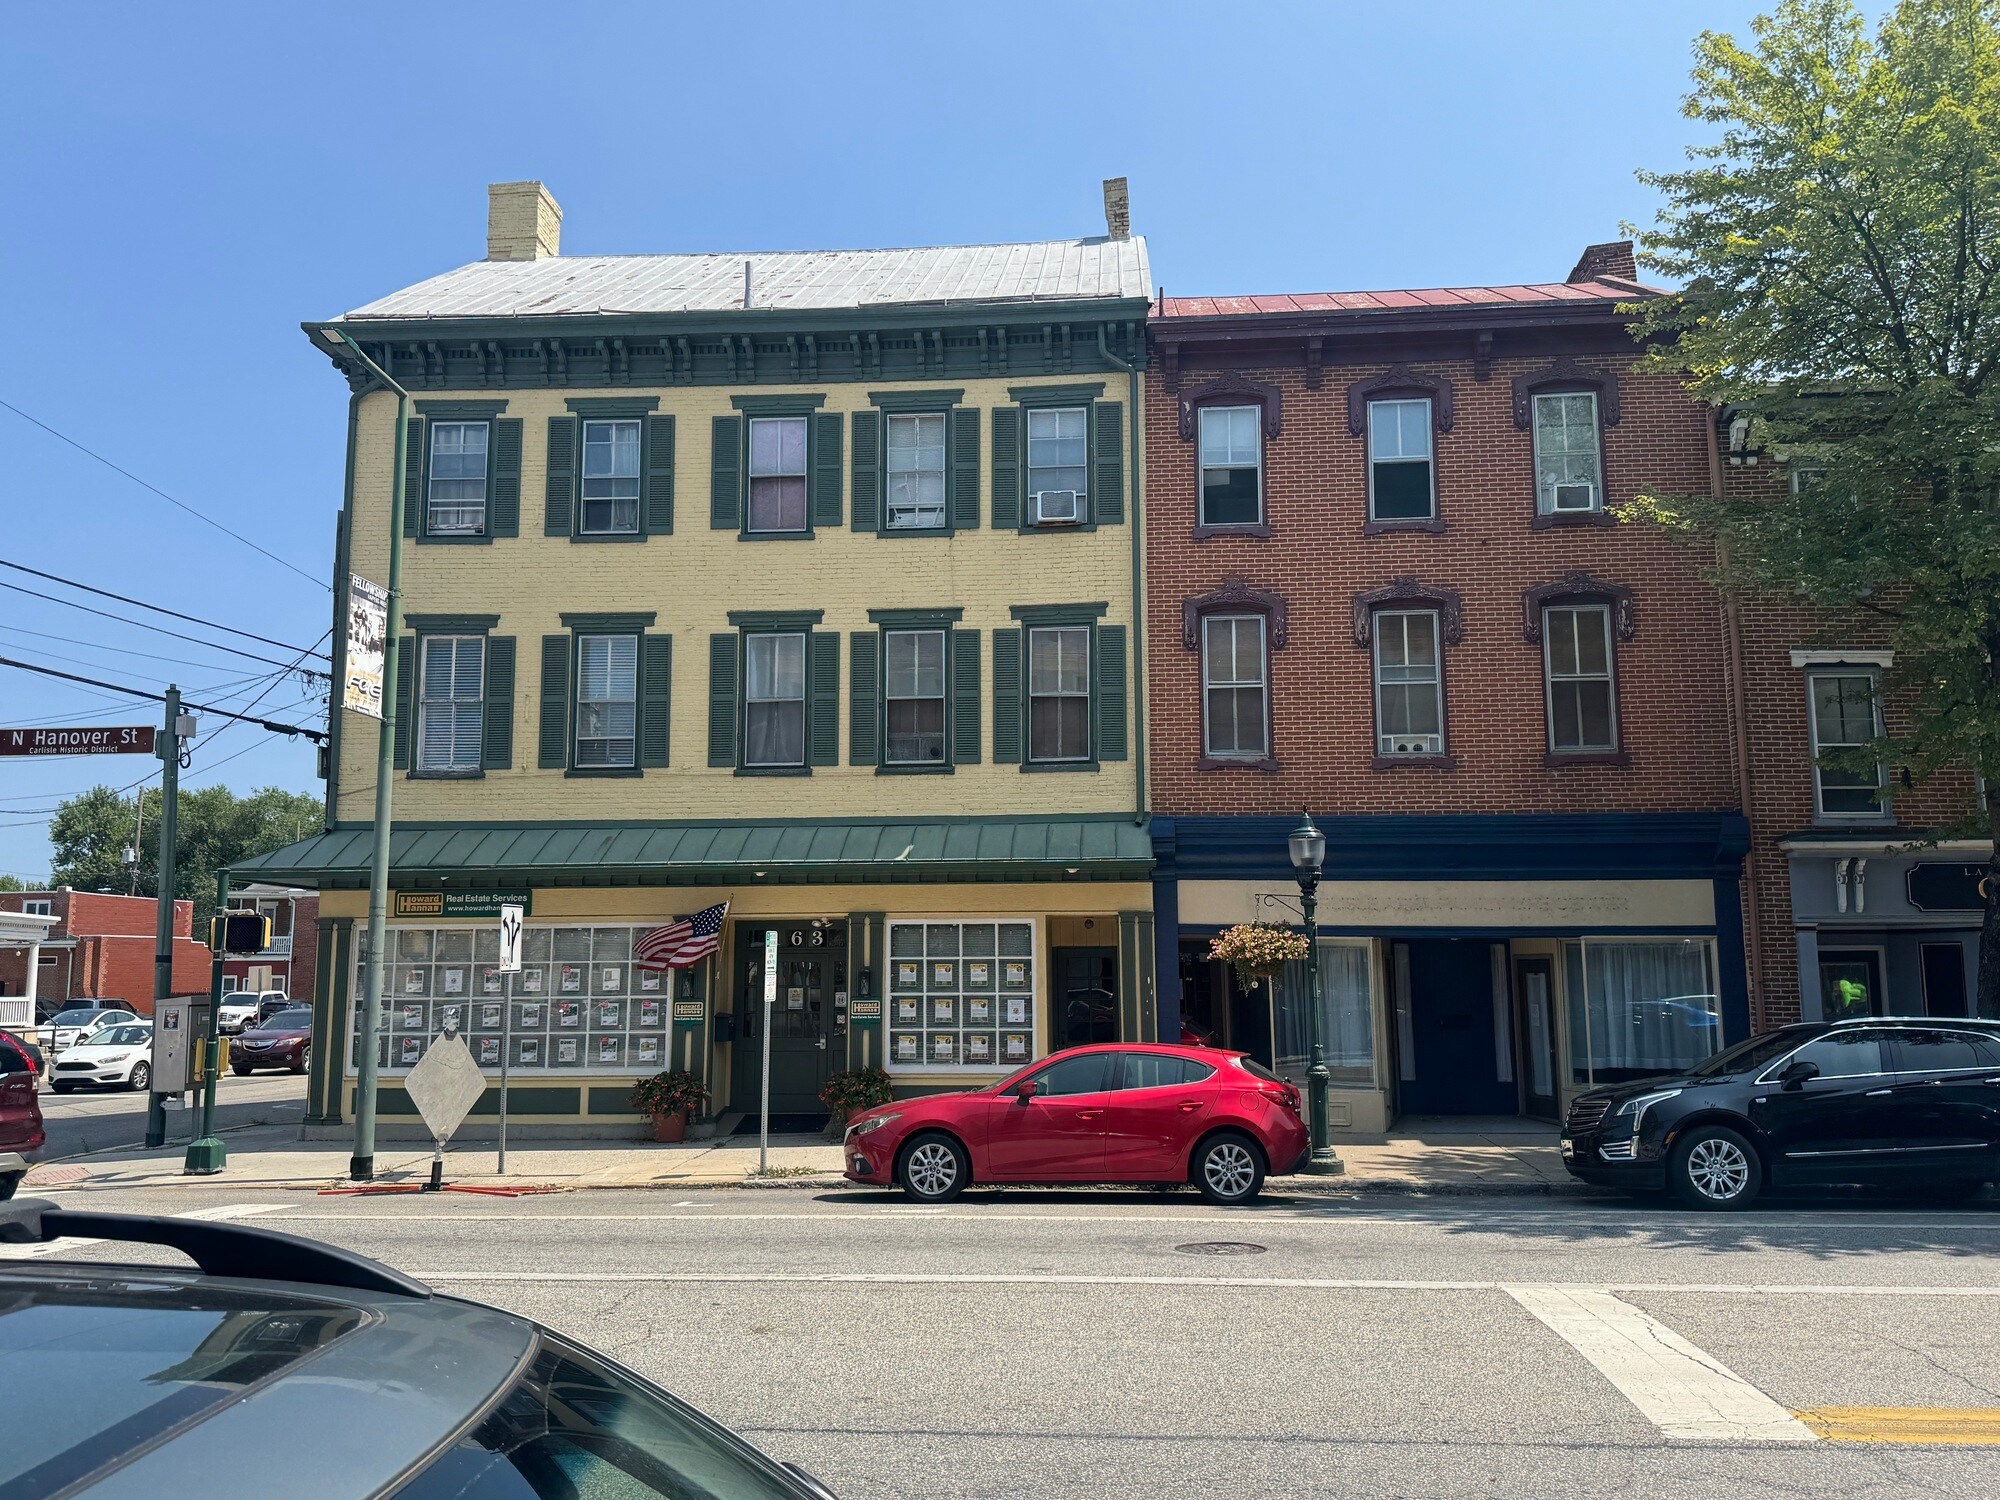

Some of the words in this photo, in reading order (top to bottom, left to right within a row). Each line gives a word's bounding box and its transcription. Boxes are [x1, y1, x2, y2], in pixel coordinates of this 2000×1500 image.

[12, 731, 24, 746] N
[35, 730, 110, 745] Hanover
[120, 728, 138, 744] St
[29, 746, 57, 754] Carlisle
[91, 745, 118, 753] District
[400, 895, 440, 904] Howard
[446, 894, 464, 903] Real
[465, 894, 491, 903] Estate
[492, 893, 528, 903] Services
[447, 904, 502, 912] www.howardhan
